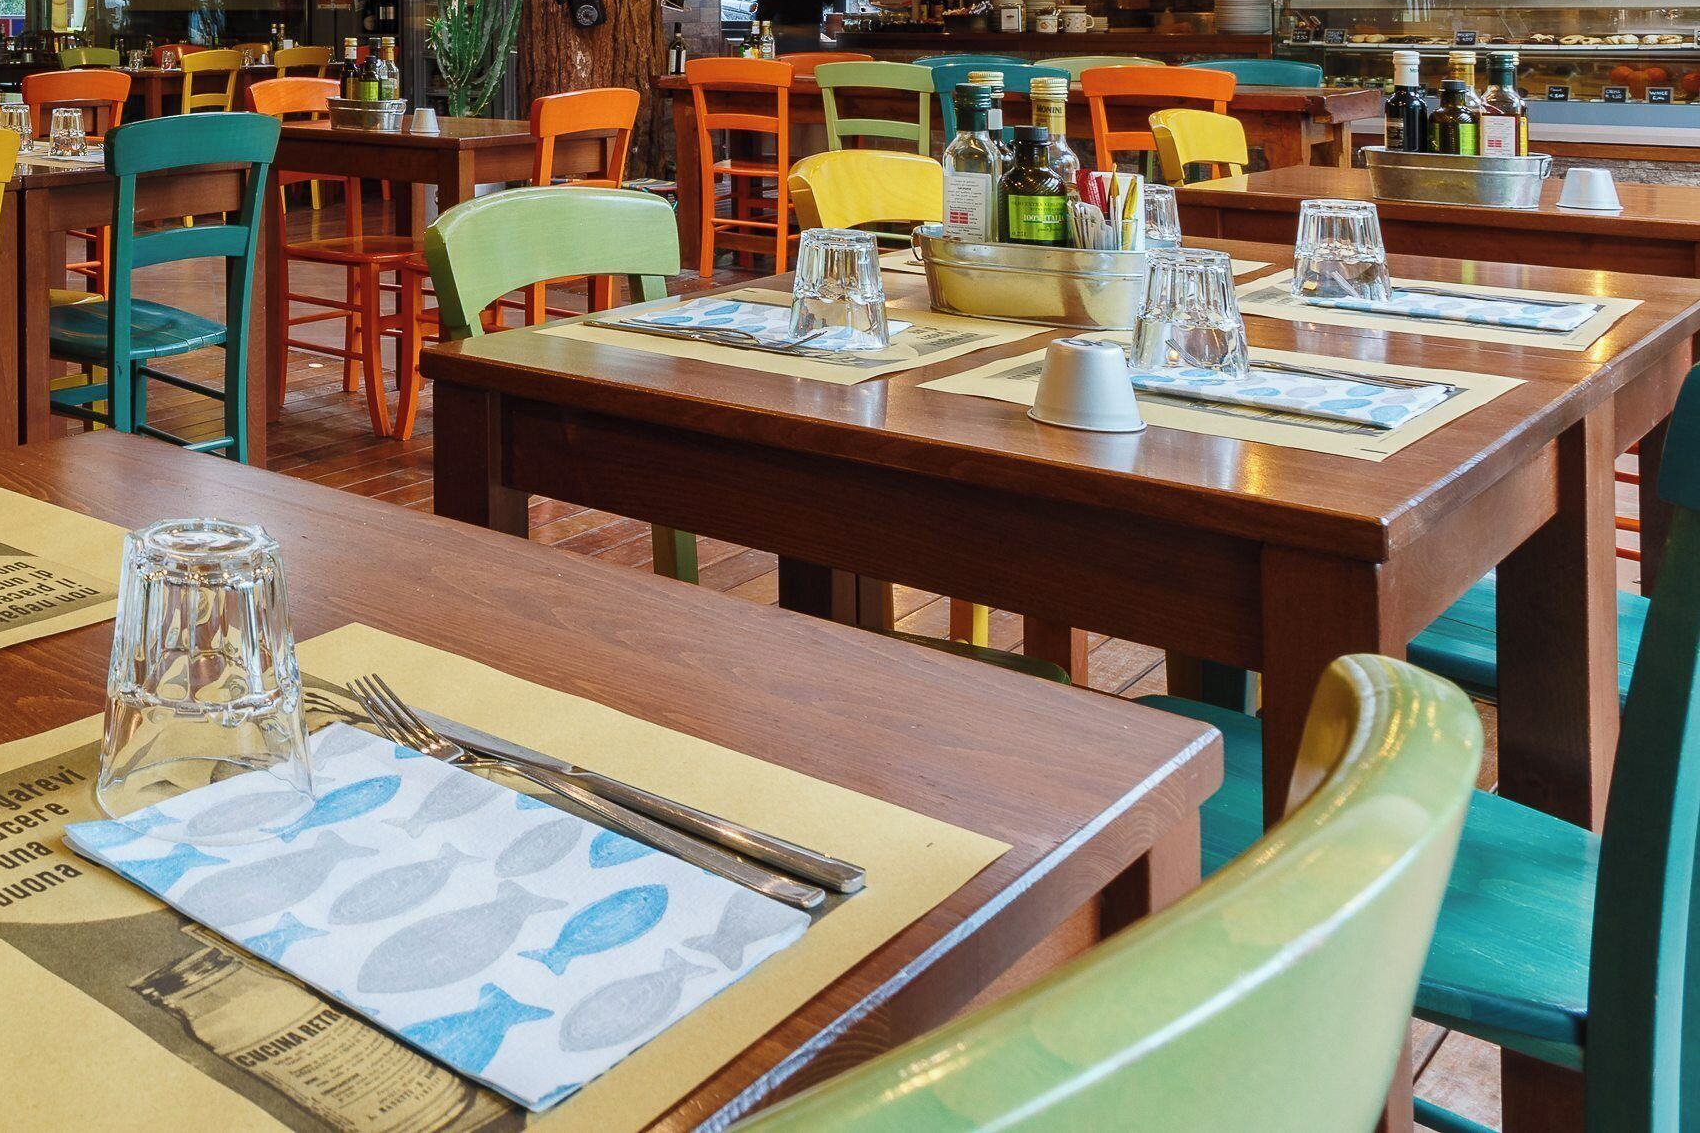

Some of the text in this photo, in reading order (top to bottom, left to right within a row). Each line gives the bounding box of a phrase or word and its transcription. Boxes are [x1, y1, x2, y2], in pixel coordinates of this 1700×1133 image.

[1036, 104, 1062, 114] MONINI
[28, 569, 55, 581] di
[55, 577, 82, 589] il
[56, 586, 101, 602] non
[234, 1031, 305, 1068] CUCINA
[300, 1008, 343, 1038] RETR
